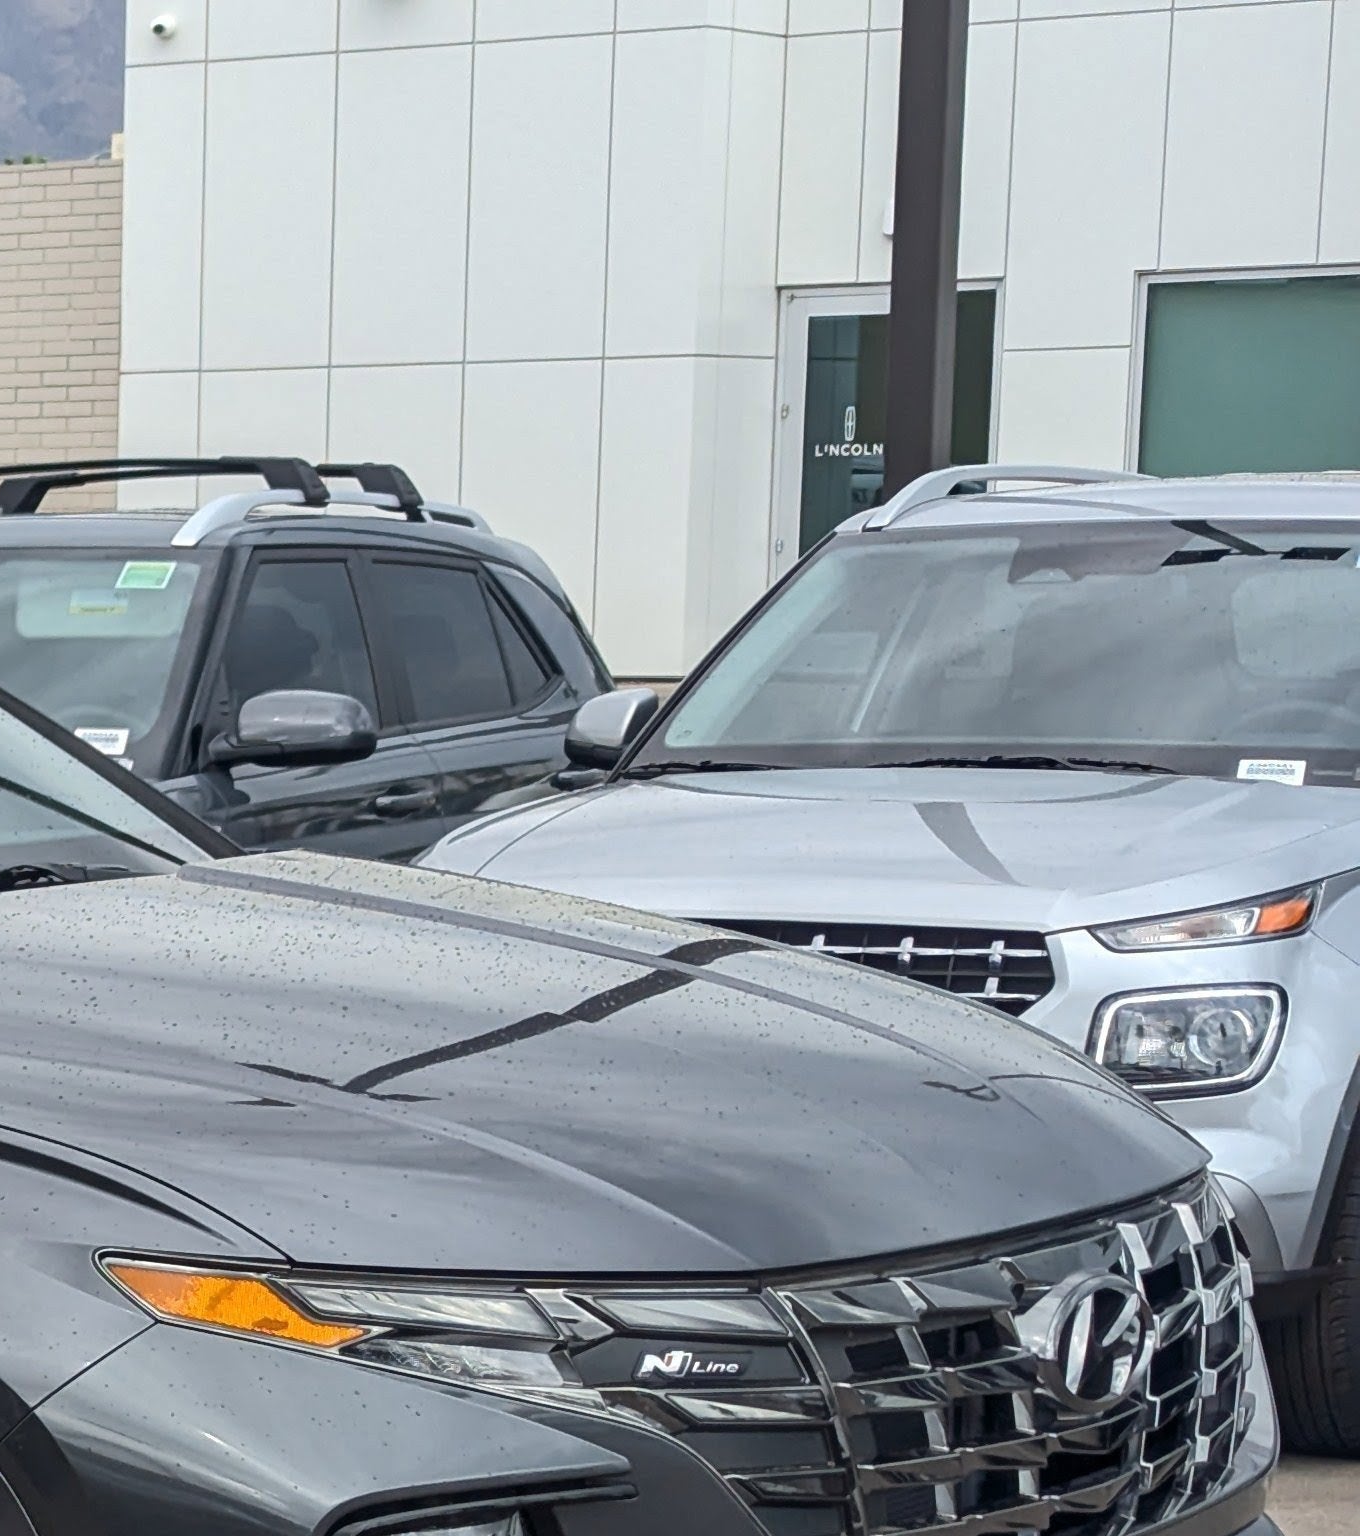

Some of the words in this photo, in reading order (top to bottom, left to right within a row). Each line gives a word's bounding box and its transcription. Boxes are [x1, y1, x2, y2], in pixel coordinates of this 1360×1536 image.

[814, 442, 884, 458] LINCOLN
[637, 1350, 693, 1378] N
[692, 1361, 740, 1373] Line
